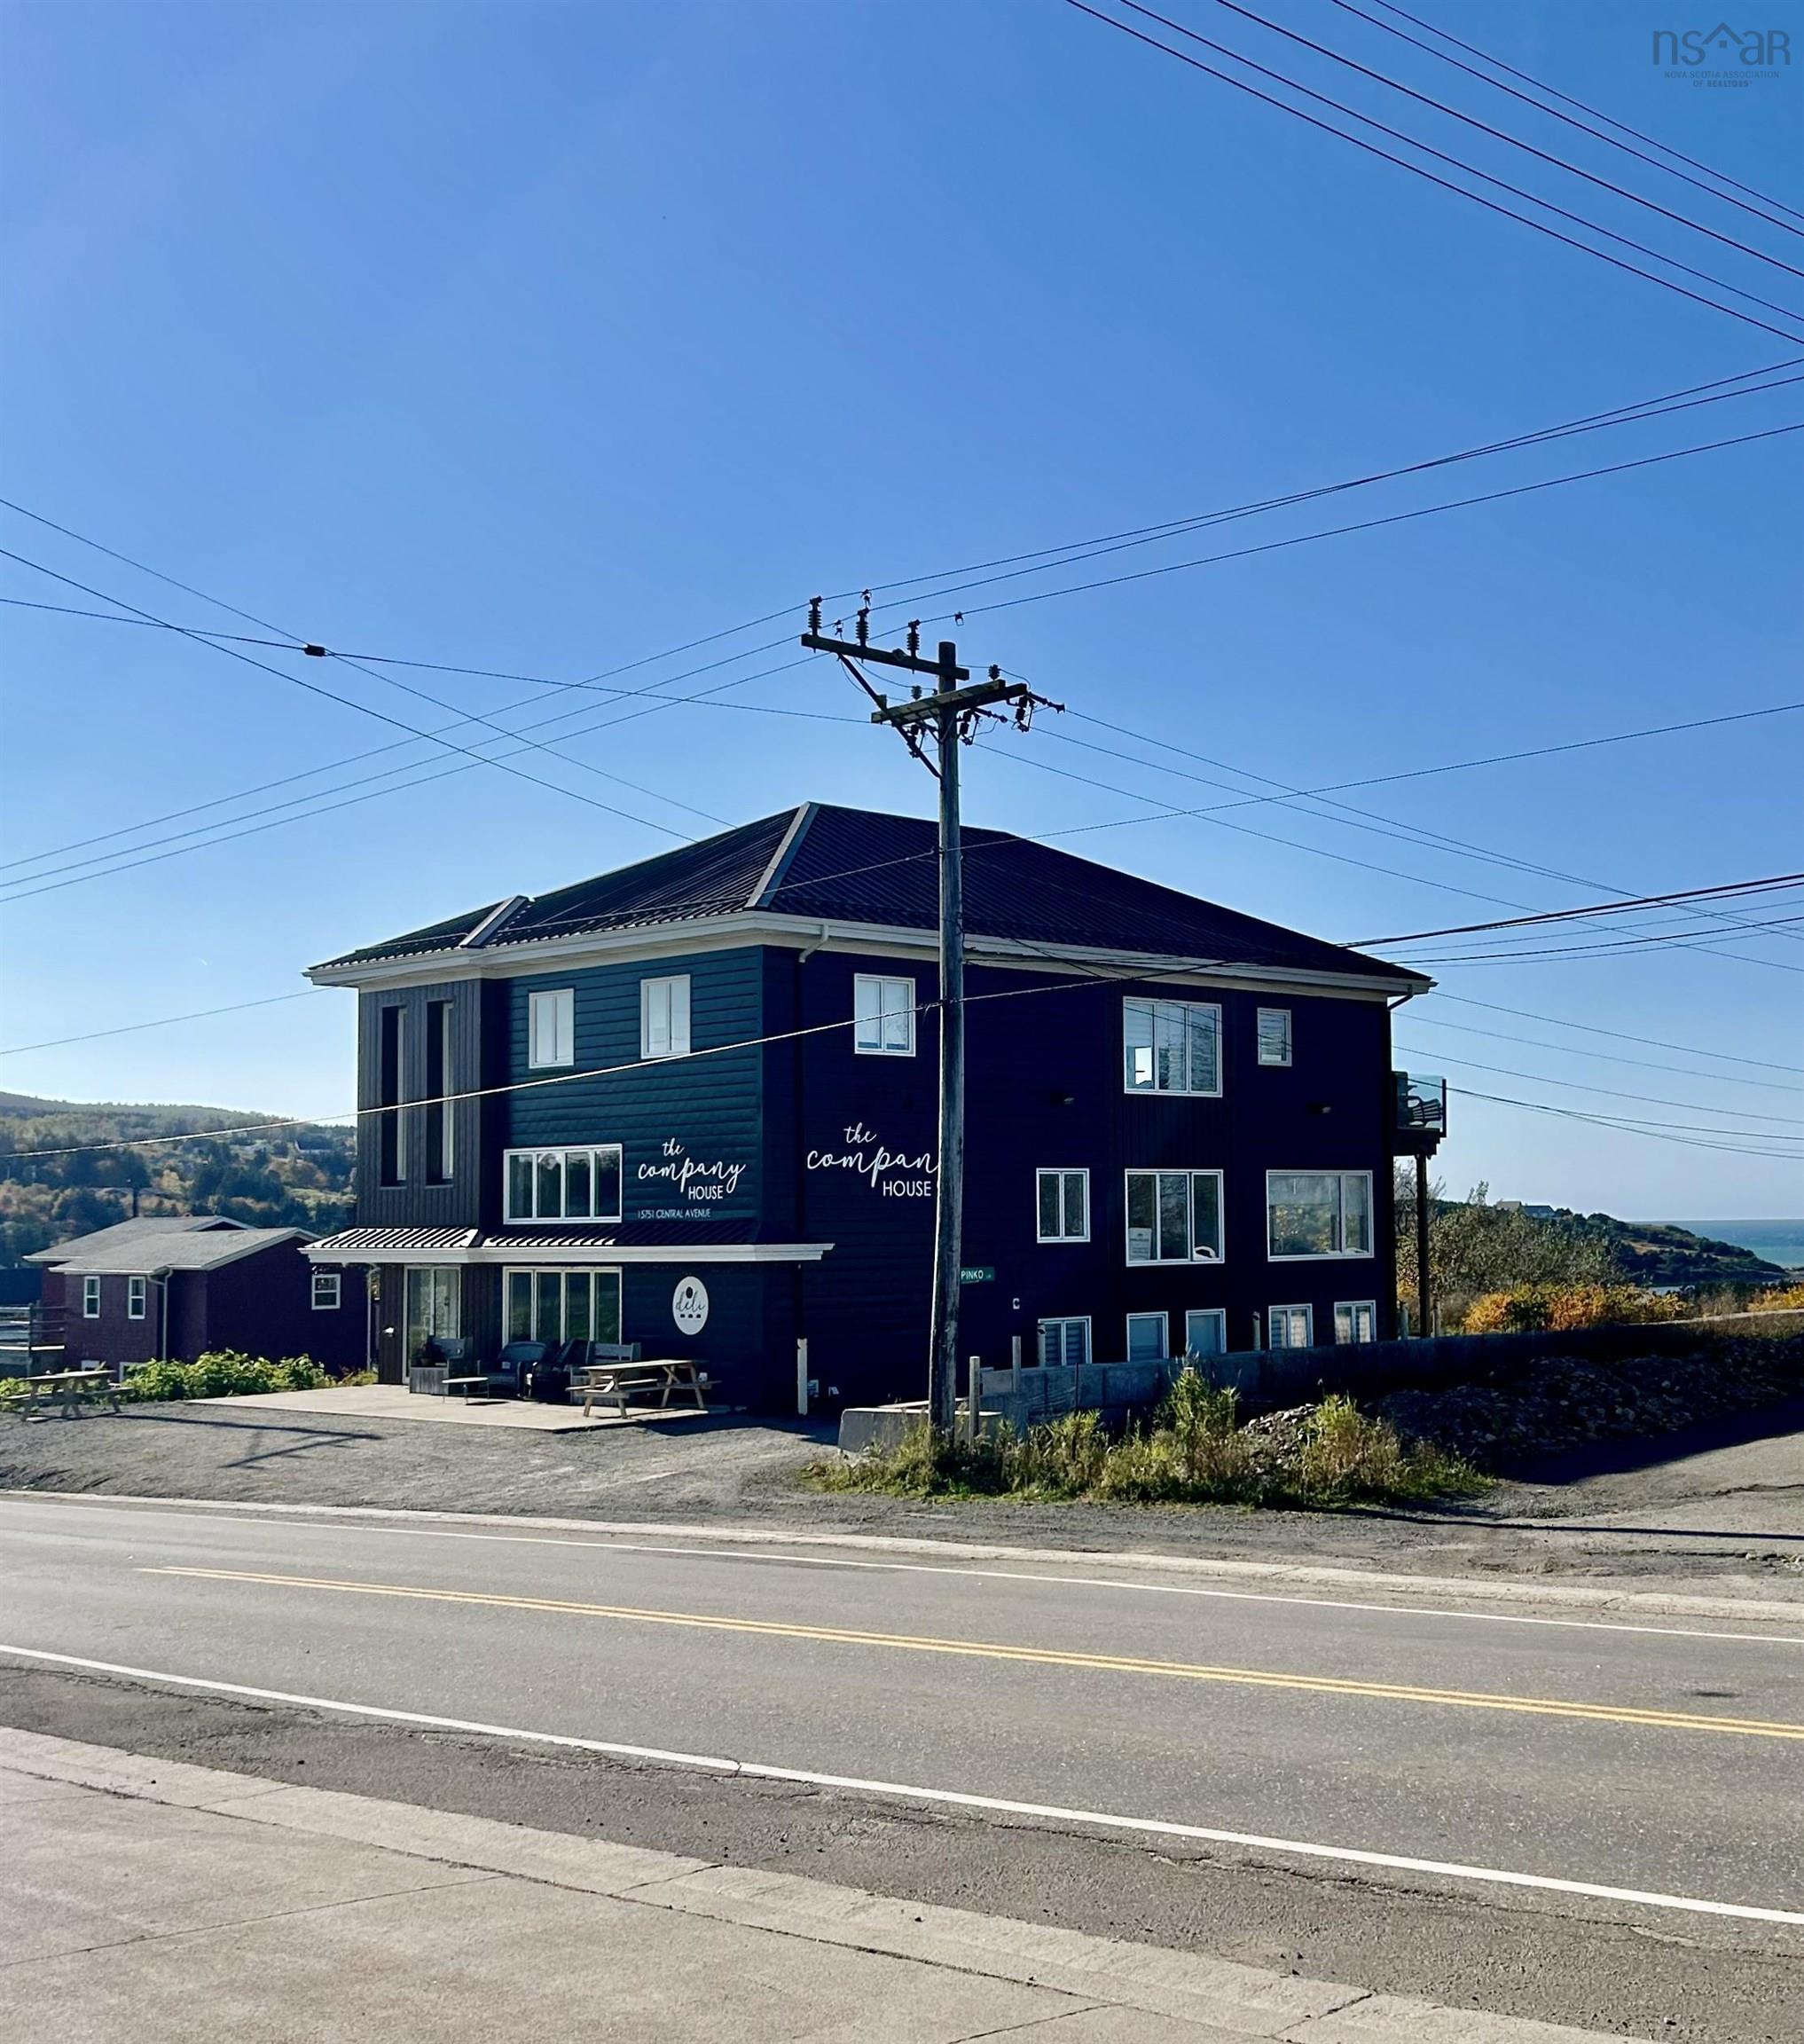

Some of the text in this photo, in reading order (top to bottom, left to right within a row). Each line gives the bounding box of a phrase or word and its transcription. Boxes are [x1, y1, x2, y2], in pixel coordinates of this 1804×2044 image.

[843, 1122, 877, 1144] the
[662, 1137, 685, 1157] the
[638, 1157, 746, 1194] company
[807, 1146, 939, 1188] compan
[687, 1185, 724, 1200] HOUSE
[882, 1180, 931, 1197] HOUSE
[655, 1208, 684, 1219] CENTRAL
[685, 1207, 711, 1218] AVENUE
[961, 1270, 984, 1280] PINKO
[676, 1290, 705, 1313] deli
